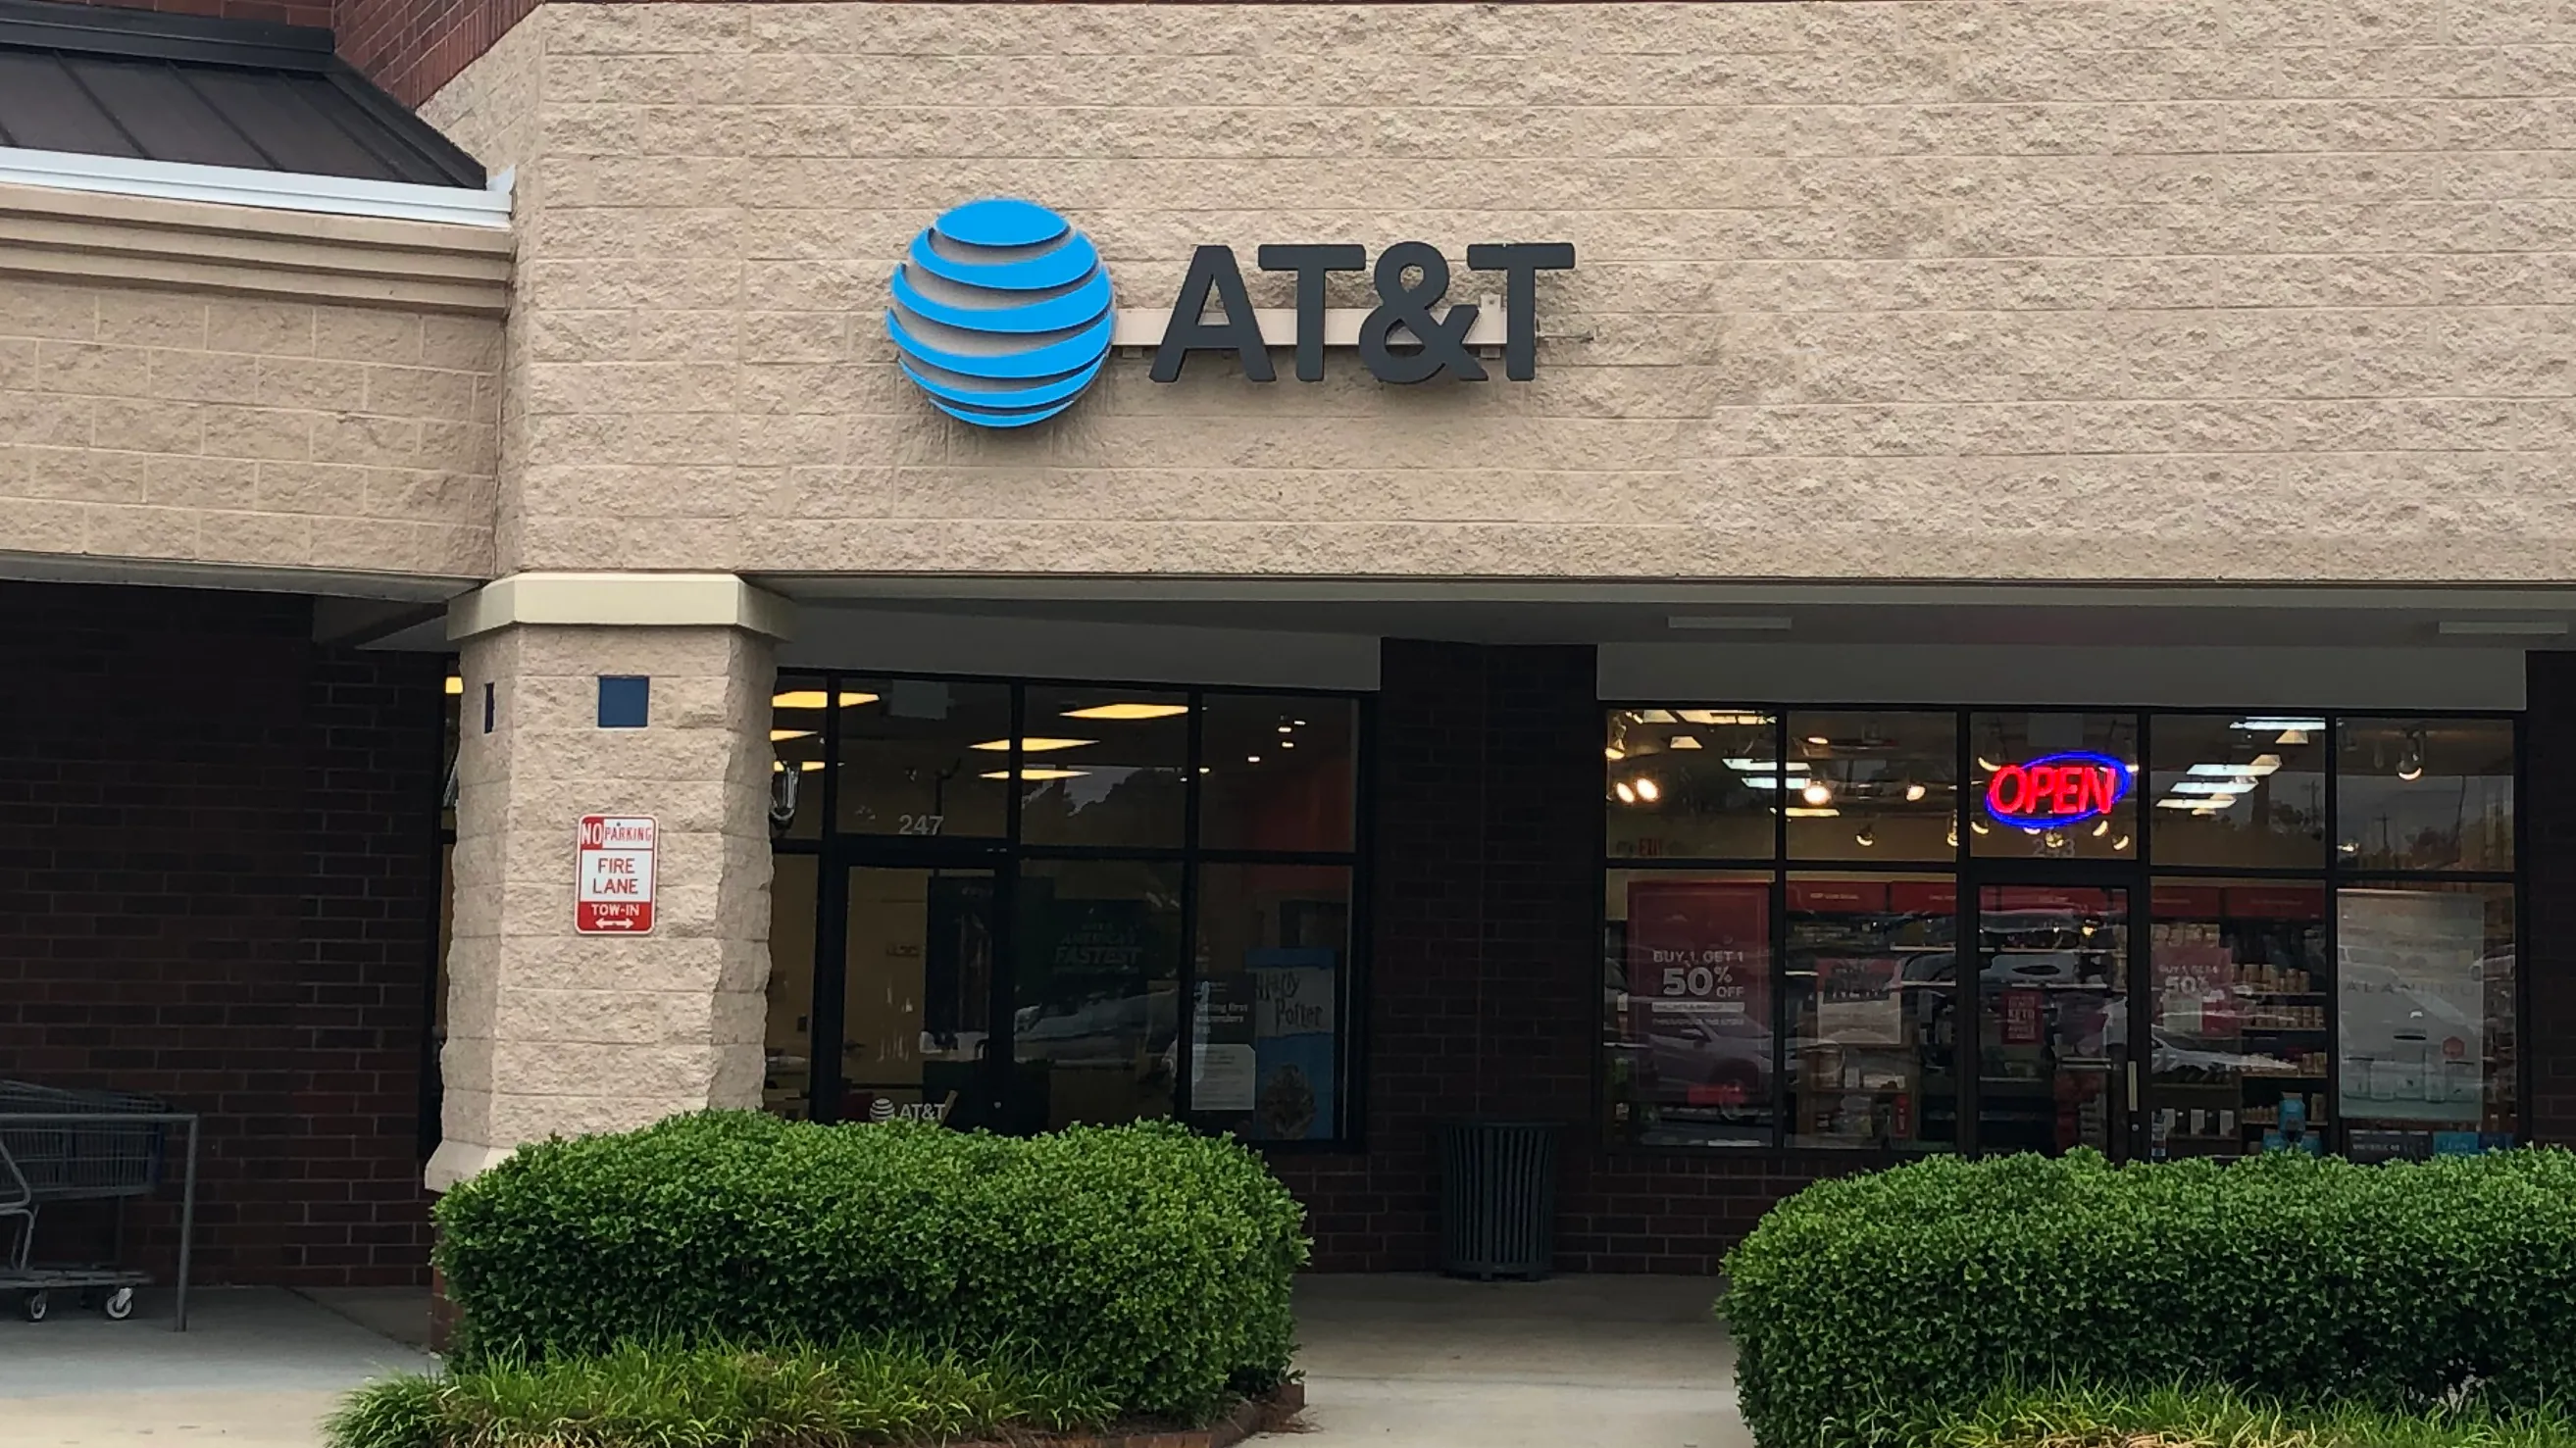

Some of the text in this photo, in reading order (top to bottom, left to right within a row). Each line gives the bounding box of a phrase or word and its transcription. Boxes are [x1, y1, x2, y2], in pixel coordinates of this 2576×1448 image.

[1148, 241, 1575, 384] AT&T
[1988, 763, 2116, 815] OPEN
[581, 822, 652, 845] NO PARKING
[898, 815, 944, 836] 247
[597, 858, 635, 874] FIRE
[592, 877, 639, 894] LANE
[591, 903, 640, 916] TOW-IN
[1055, 946, 1143, 965] FASTEST
[1653, 950, 1684, 963] BUY
[1702, 950, 1734, 964] GET
[1737, 951, 1743, 963] 1
[1255, 971, 1300, 1000] Harry
[1663, 965, 1733, 996] 50%
[1716, 986, 1744, 997] OFF
[1276, 998, 1325, 1034] Potter
[900, 1103, 945, 1121] AT&T
